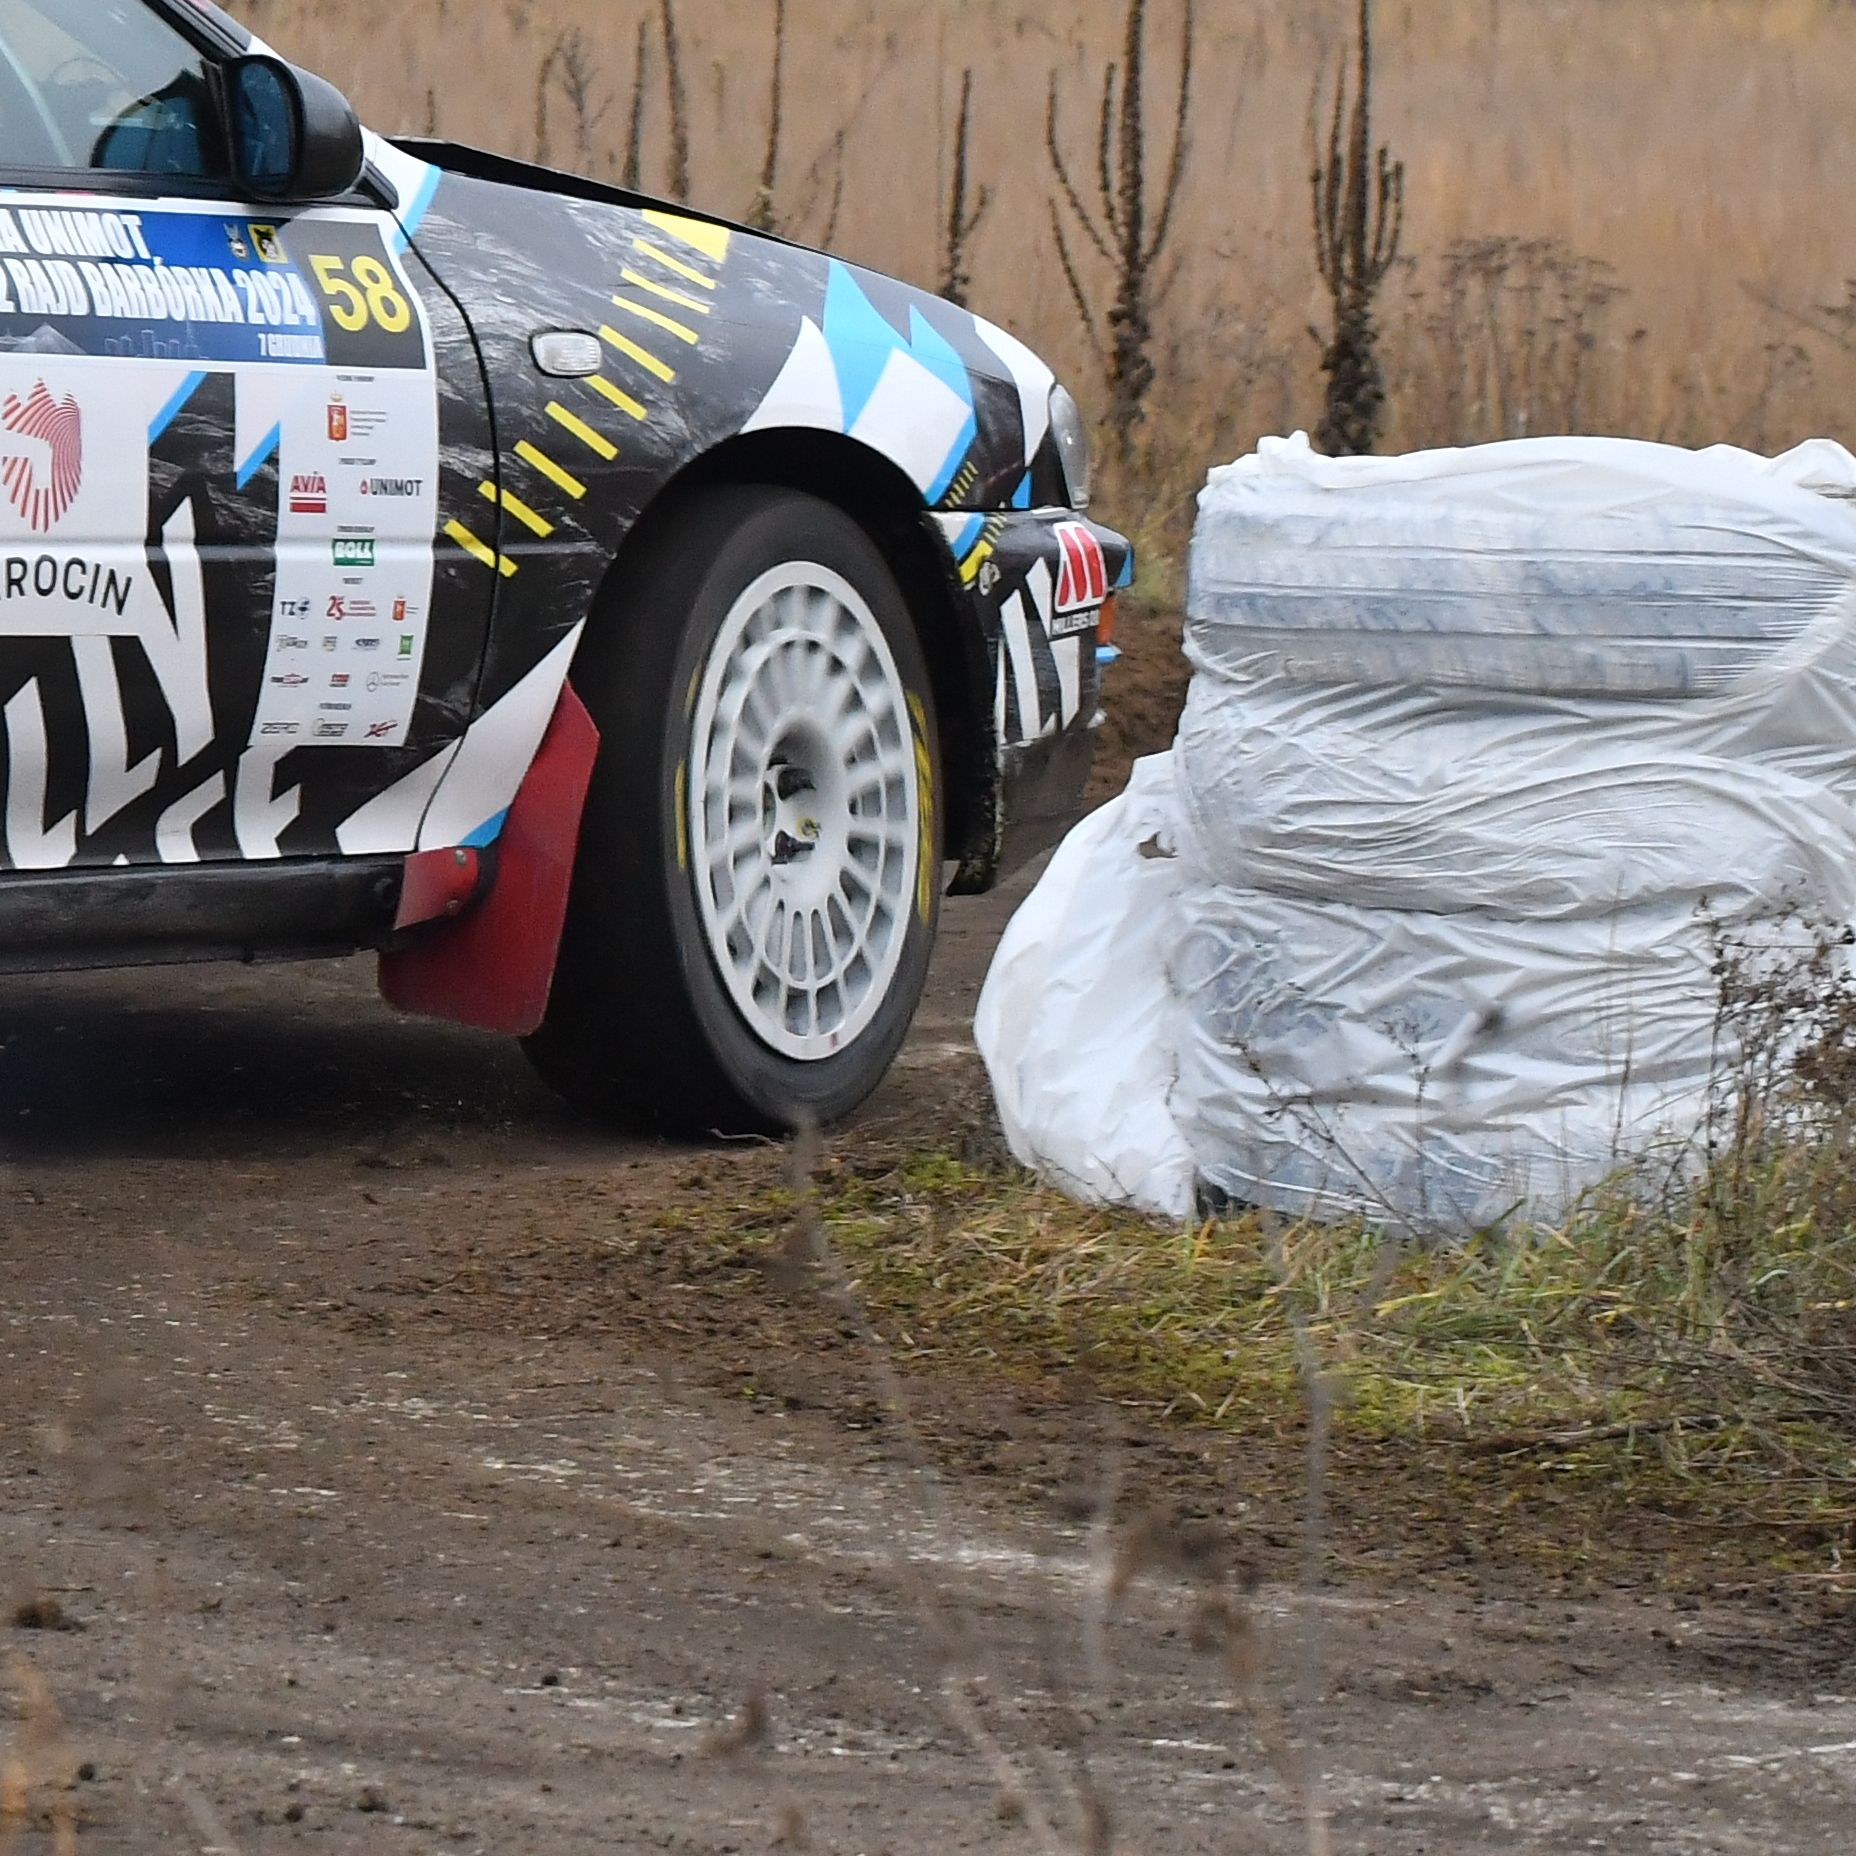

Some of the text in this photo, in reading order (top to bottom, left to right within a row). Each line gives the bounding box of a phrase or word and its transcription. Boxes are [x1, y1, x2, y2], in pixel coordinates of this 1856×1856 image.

[18, 208, 145, 261] UNIMOT
[10, 260, 89, 316] RAJD
[234, 269, 319, 326] 2024
[308, 254, 412, 333] 58
[369, 478, 423, 496] UNIMOT
[334, 541, 373, 558] BOLL
